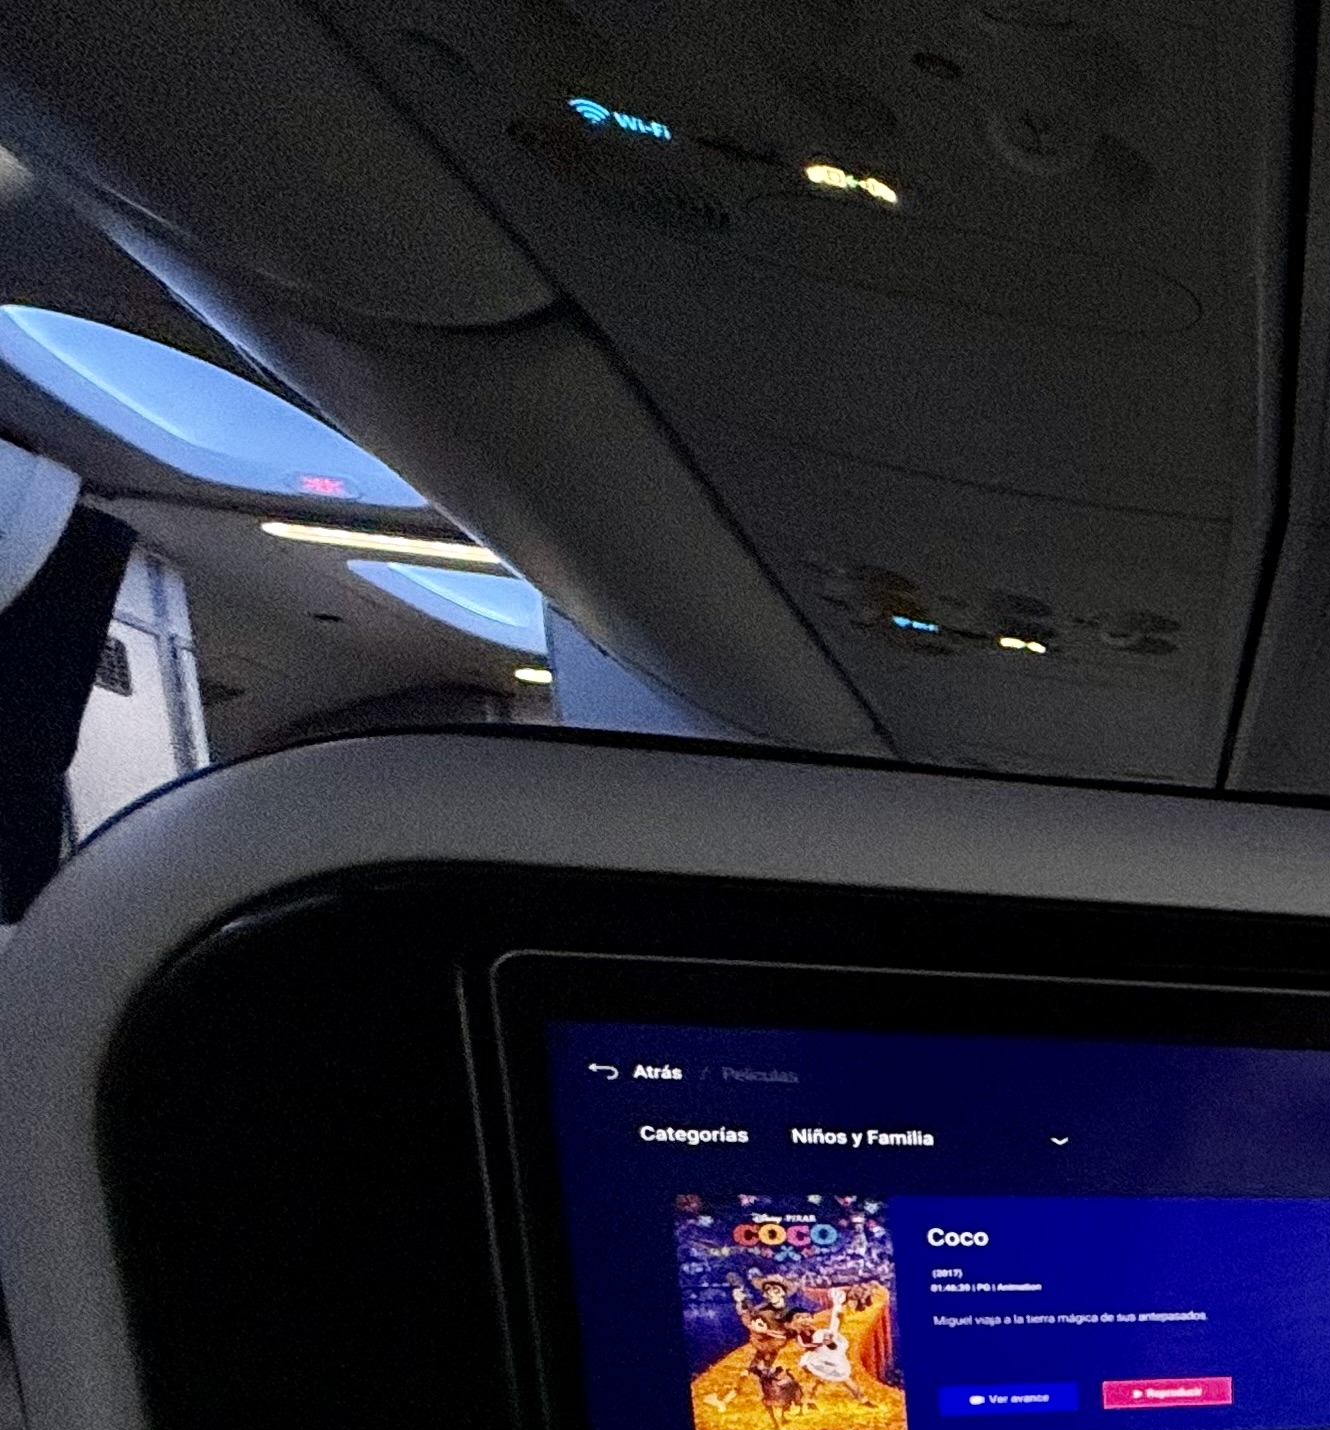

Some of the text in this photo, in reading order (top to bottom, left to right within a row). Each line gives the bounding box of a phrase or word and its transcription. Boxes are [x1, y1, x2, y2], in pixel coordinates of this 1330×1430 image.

[633, 1064, 683, 1080] Atrás
[640, 1125, 935, 1148] Categorías Niños y Familia
[733, 1223, 838, 1247] COCO
[927, 1227, 989, 1248] Coco
[933, 1314, 973, 1328] Miguel
[975, 1315, 1002, 1327] viaja
[1013, 1313, 1025, 1324] la
[1026, 1314, 1056, 1324] tierra
[1100, 1312, 1115, 1323] de
[1116, 1313, 1136, 1322] sus
